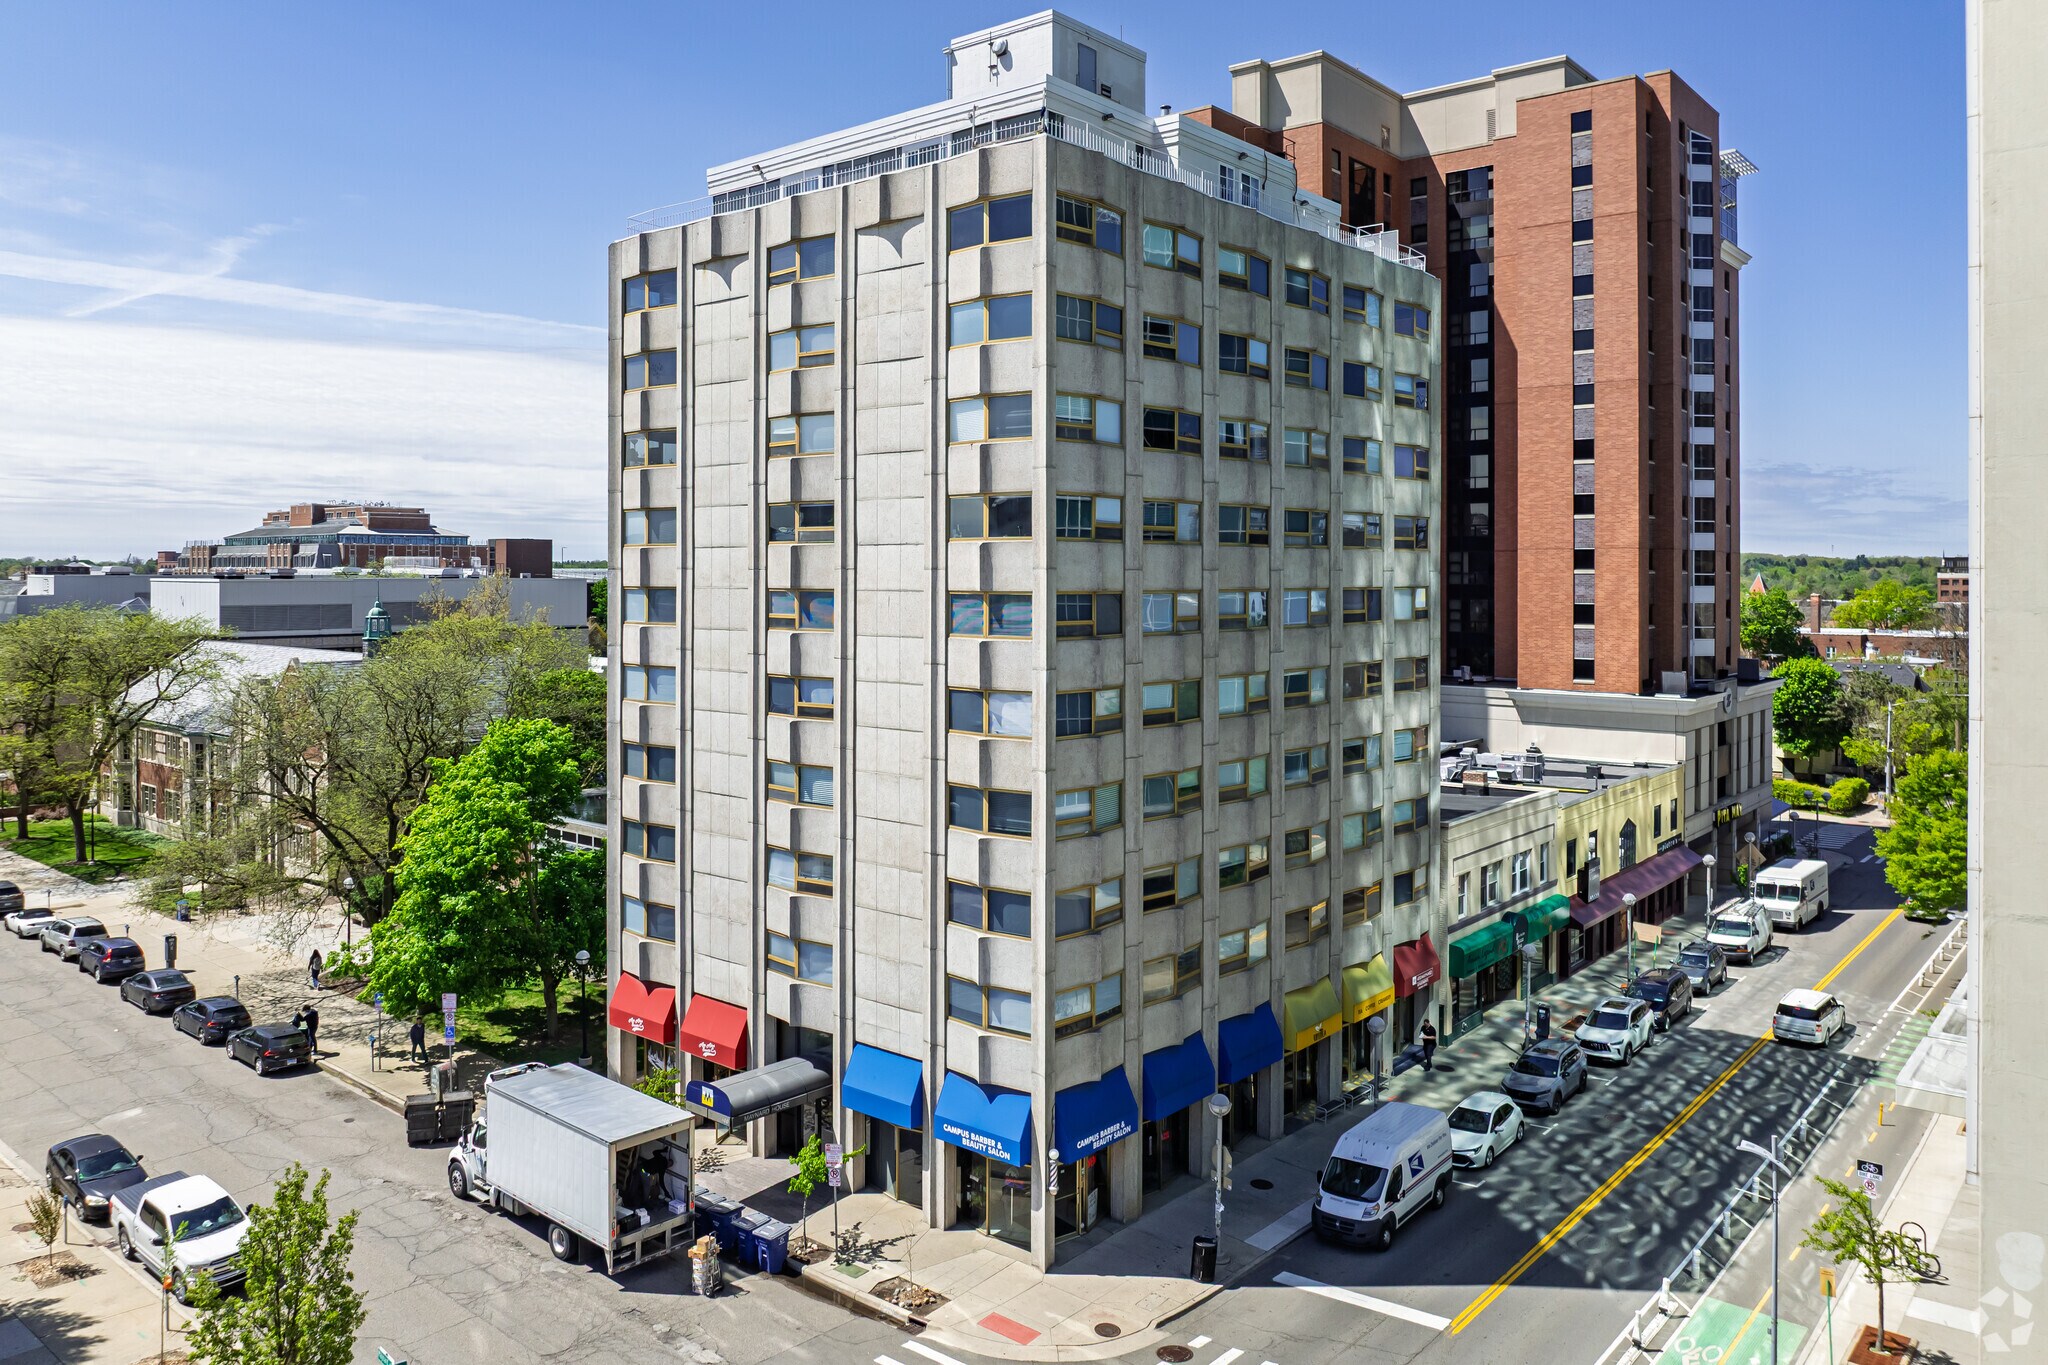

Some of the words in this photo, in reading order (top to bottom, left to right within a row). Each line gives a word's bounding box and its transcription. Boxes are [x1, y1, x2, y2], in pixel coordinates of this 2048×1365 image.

[743, 1108, 770, 1121] MAYNARD
[771, 1101, 790, 1113] HOUSE
[943, 1123, 969, 1138] CAMPUS
[970, 1132, 995, 1147] BARBER
[1076, 1132, 1099, 1149] CAMPUS
[1100, 1123, 1120, 1137] BARBER
[1092, 1133, 1113, 1149] BEAUTY
[1113, 1125, 1131, 1139] SALON
[962, 1138, 986, 1152] BEAUTY
[988, 1146, 1011, 1160] SALON
